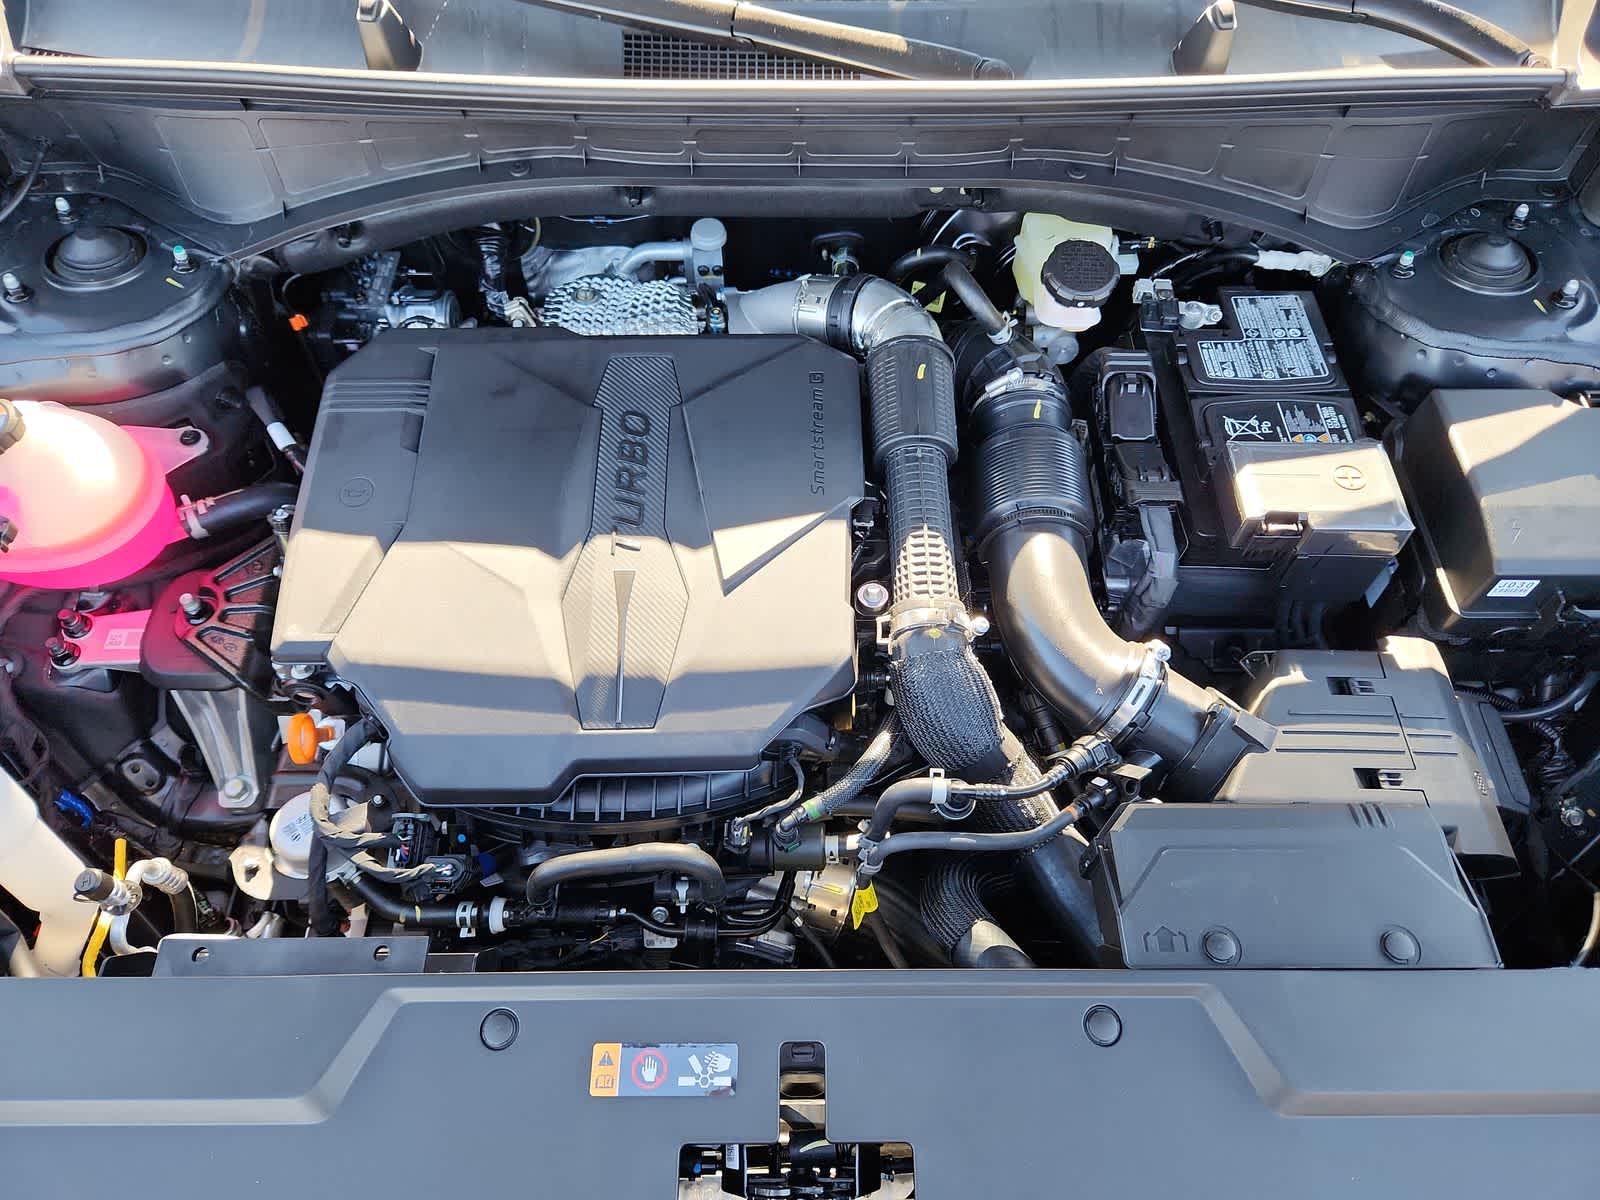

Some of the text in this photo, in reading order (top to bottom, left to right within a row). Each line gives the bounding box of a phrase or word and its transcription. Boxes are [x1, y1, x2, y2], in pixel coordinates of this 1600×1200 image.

[809, 388, 825, 496] Smartstream
[1260, 420, 1274, 434] Pb
[611, 410, 651, 555] TURBO
